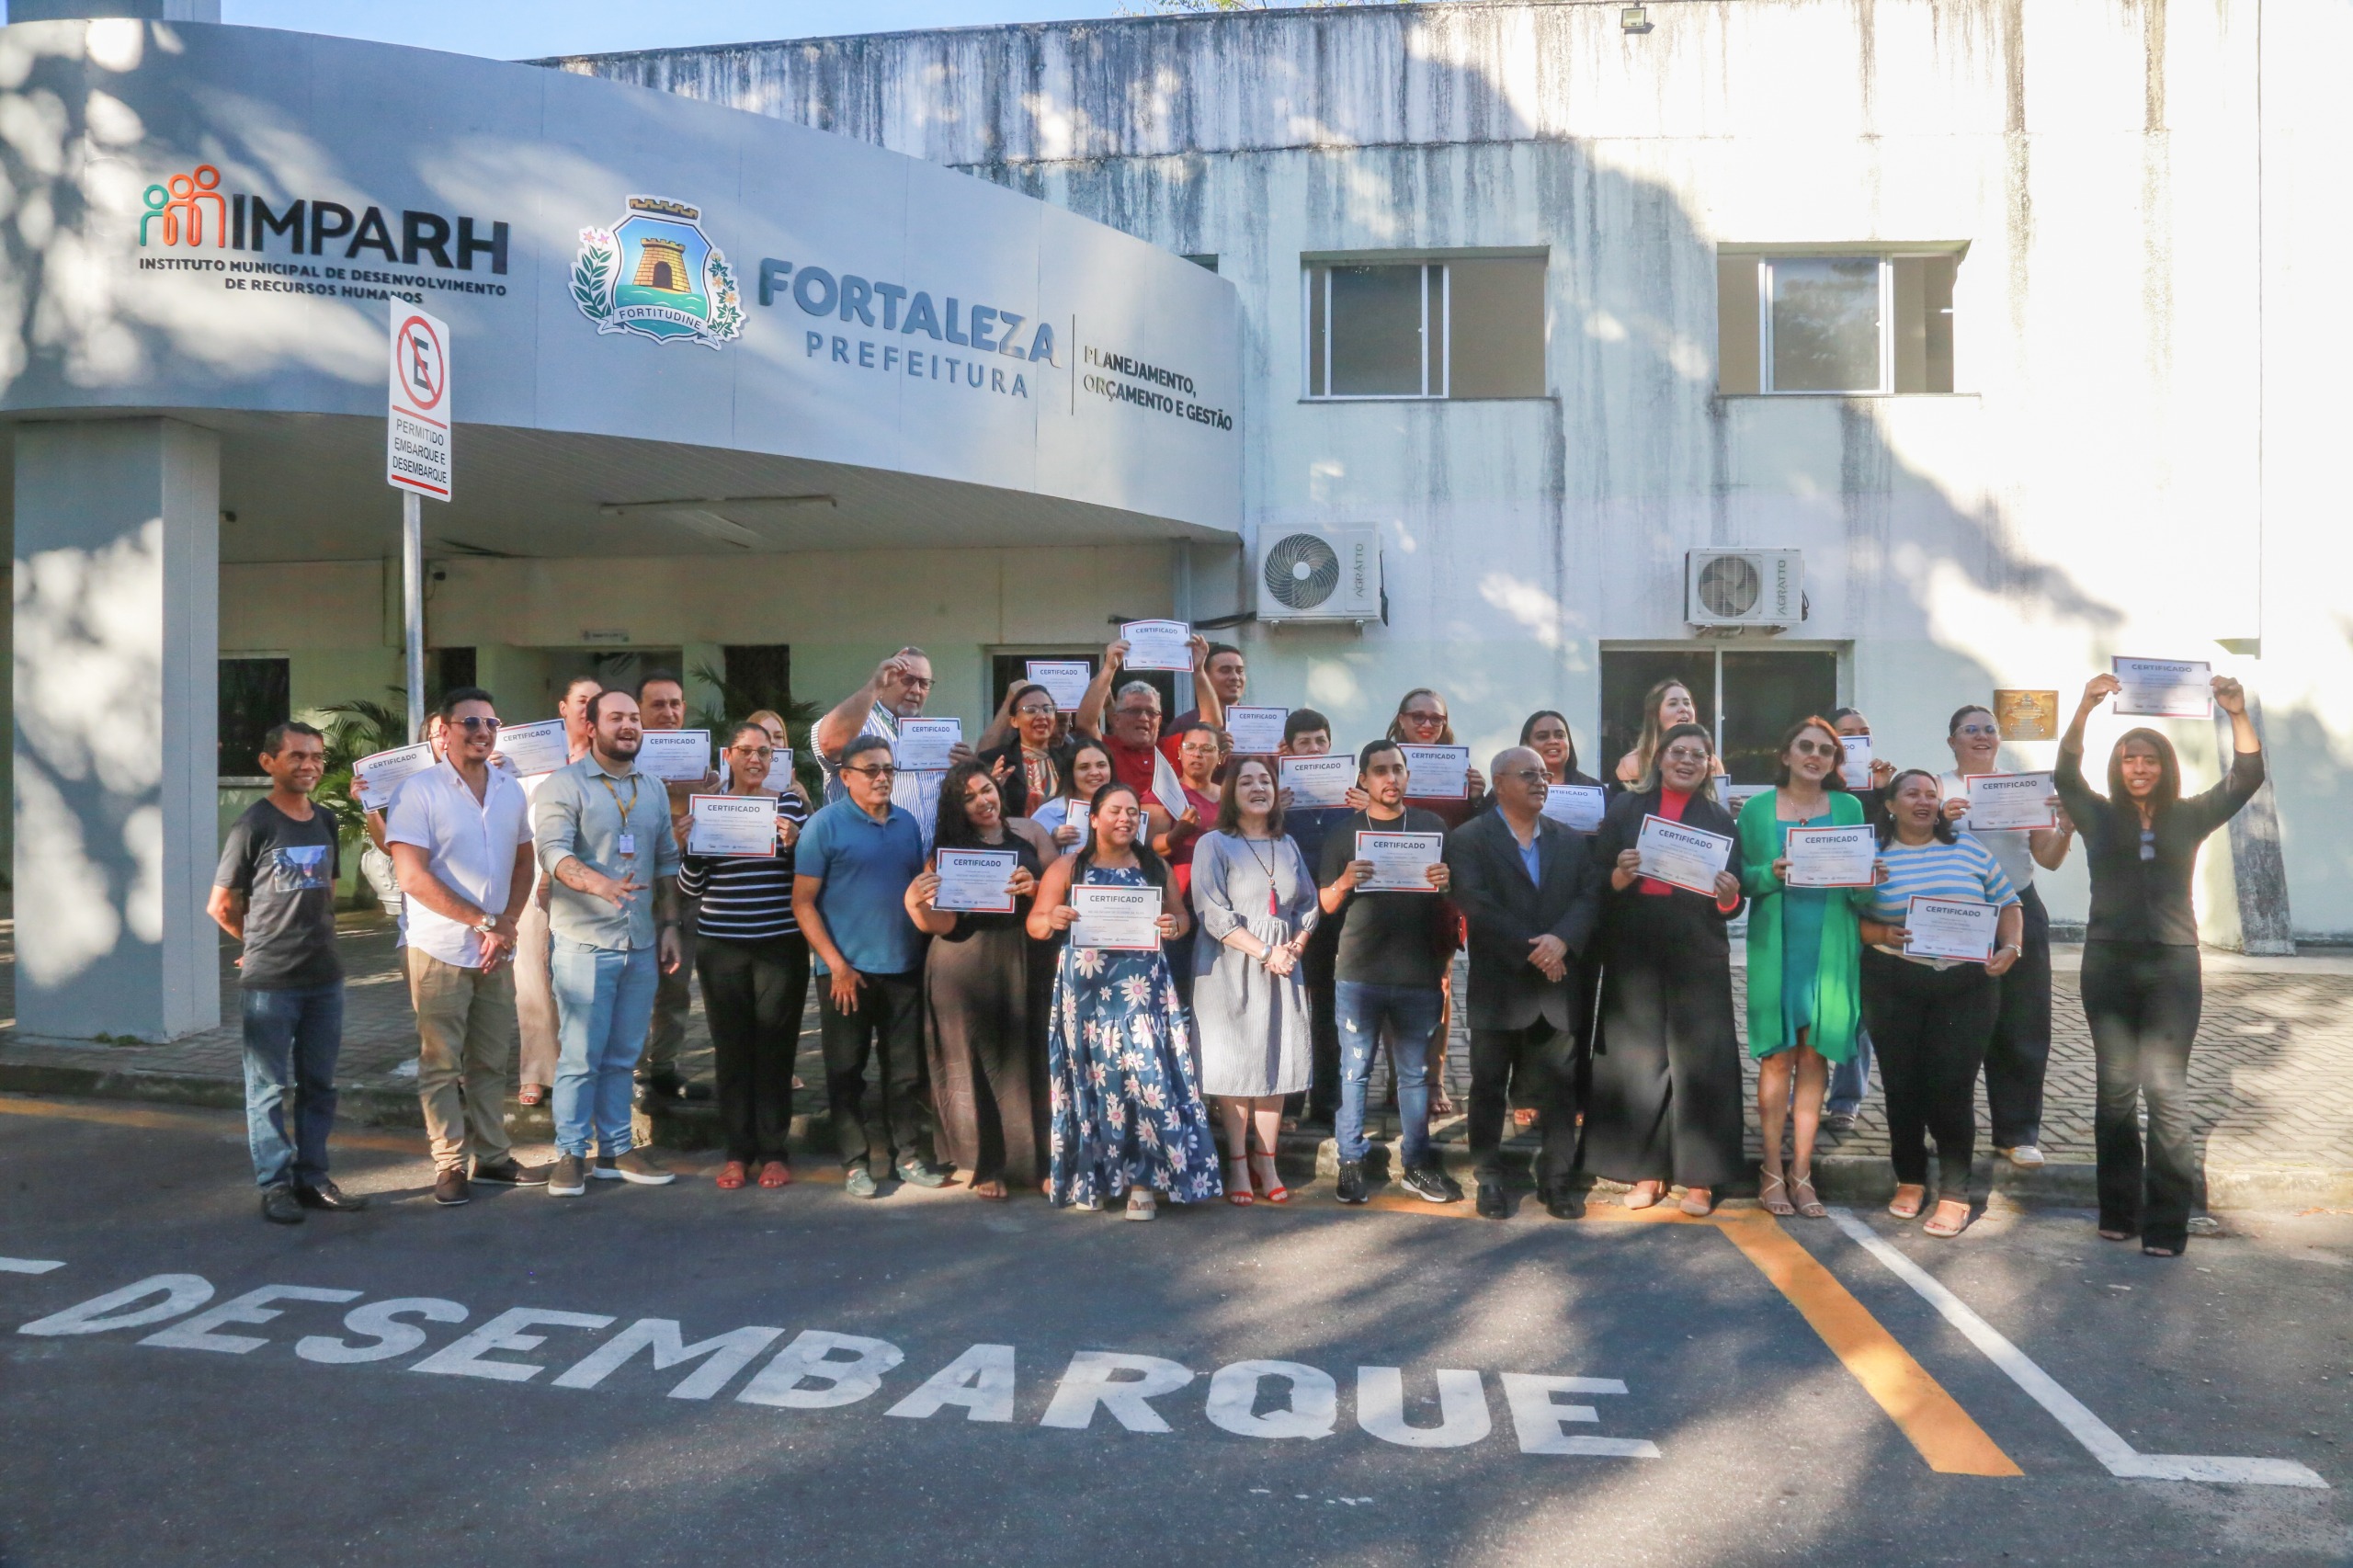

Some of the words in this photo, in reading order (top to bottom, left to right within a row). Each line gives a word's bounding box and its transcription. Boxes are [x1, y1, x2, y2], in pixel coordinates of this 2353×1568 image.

[232, 193, 508, 275] IMPARH
[140, 258, 225, 272] INSTITUTO
[230, 260, 320, 278] MUNICIPAL
[325, 267, 346, 279] DE
[351, 269, 506, 297] DESENVOLVIMENTO
[225, 278, 246, 290] DE
[251, 279, 336, 296] RECURSOS
[620, 308, 702, 330] FORTITUDINE
[759, 257, 1062, 369] FORTALEZA
[807, 331, 1029, 398] PREFEITURA
[1085, 345, 1197, 398] PLANEJAMENTO,
[1084, 374, 1174, 414] ORÇAMENTO
[1176, 400, 1184, 417] E
[1186, 403, 1233, 431] GESTÃO
[396, 418, 444, 447] PERMITIDO
[394, 437, 438, 463] EMBARQUE
[440, 453, 446, 466] E
[392, 455, 447, 483] DESEMBARQUE
[1354, 543, 1364, 598] AGRATTO
[1778, 560, 1787, 616] AGRATTO
[2131, 664, 2192, 673] CERTIFICADO
[503, 729, 551, 742] CERTIFICADO
[369, 754, 417, 769] CERTIFICADO
[1411, 752, 1456, 760] CERTIFICADO
[1294, 763, 1341, 771] CERTIFICADO
[1983, 780, 2037, 790] CERTIFICADO
[707, 804, 760, 812] CERTIFICADO
[1373, 841, 1426, 849] CERTIFICADO
[1658, 829, 1712, 849] CERTIFICADO
[1805, 835, 1859, 844] CERTIFICADO
[953, 858, 1001, 867] CERTIFICADO
[1089, 895, 1143, 903] CERTIFICADO
[1926, 905, 1981, 917] CERTIFICADO
[17, 1273, 1661, 1459] DESEMBARQUE
